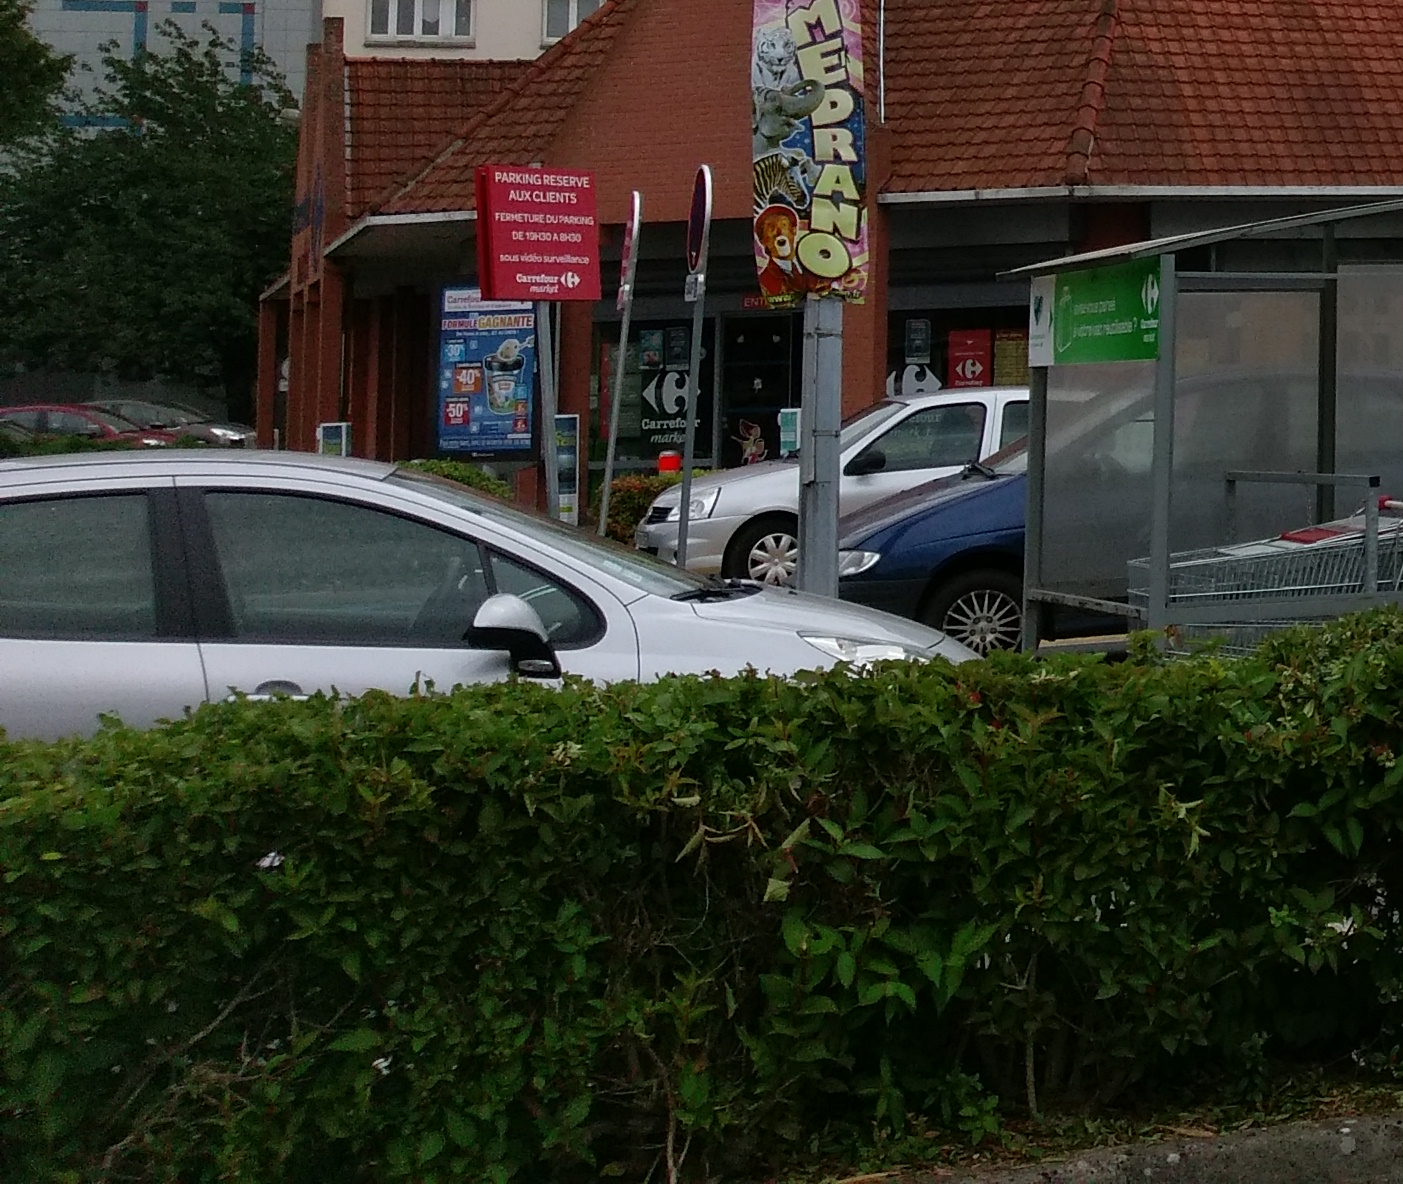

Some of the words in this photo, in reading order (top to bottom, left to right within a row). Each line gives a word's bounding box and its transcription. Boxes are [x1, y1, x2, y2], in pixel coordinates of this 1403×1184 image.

[495, 172, 541, 185] PARKING
[543, 176, 590, 188] RESERVE
[508, 191, 531, 202] AUX
[532, 191, 577, 204] CLIENTS
[495, 212, 545, 224] FERMETURE
[546, 214, 558, 224] DU
[559, 215, 594, 226] PARKING
[512, 231, 524, 241] DE
[500, 254, 519, 264] sous
[516, 273, 558, 284] Carrefour
[530, 284, 558, 294] market
[443, 319, 478, 329] FORMULE
[478, 315, 533, 329] GAGNANTE
[446, 402, 468, 418] -50%
[641, 418, 700, 430] Carrefor
[650, 431, 686, 444] marke
